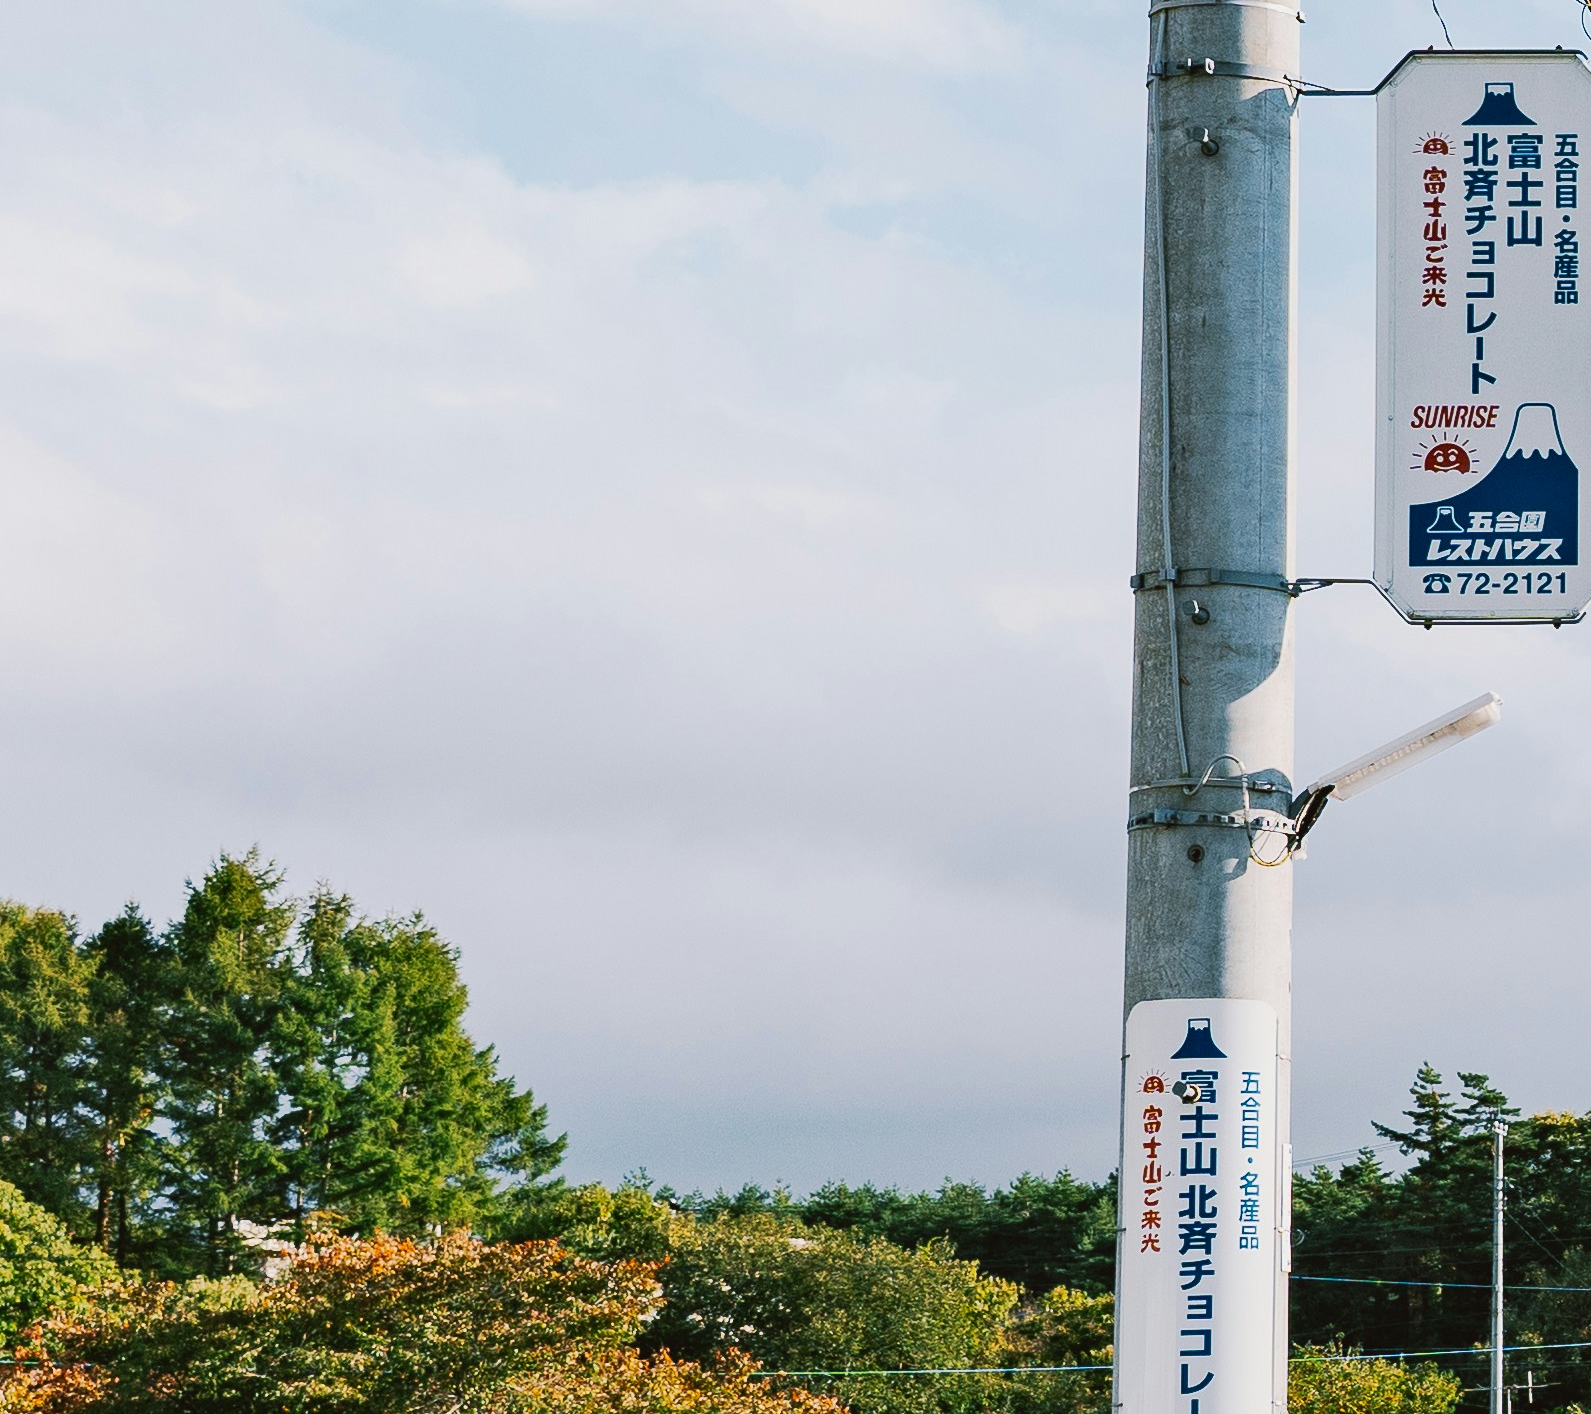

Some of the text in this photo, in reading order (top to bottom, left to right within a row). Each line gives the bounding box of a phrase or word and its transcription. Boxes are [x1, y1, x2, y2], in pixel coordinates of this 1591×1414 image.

[1422, 166, 1448, 308] 富士山ご来光
[1506, 133, 1543, 247] 富士山
[1554, 133, 1579, 305] 五合目・名産品
[1410, 405, 1500, 429] SUNRISE
[1426, 538, 1563, 561] レストハウス
[1457, 572, 1568, 595] 72-2121
[1140, 1105, 1162, 1253] 富士山ご来光
[1239, 1071, 1261, 1249] 五合目・名産品
